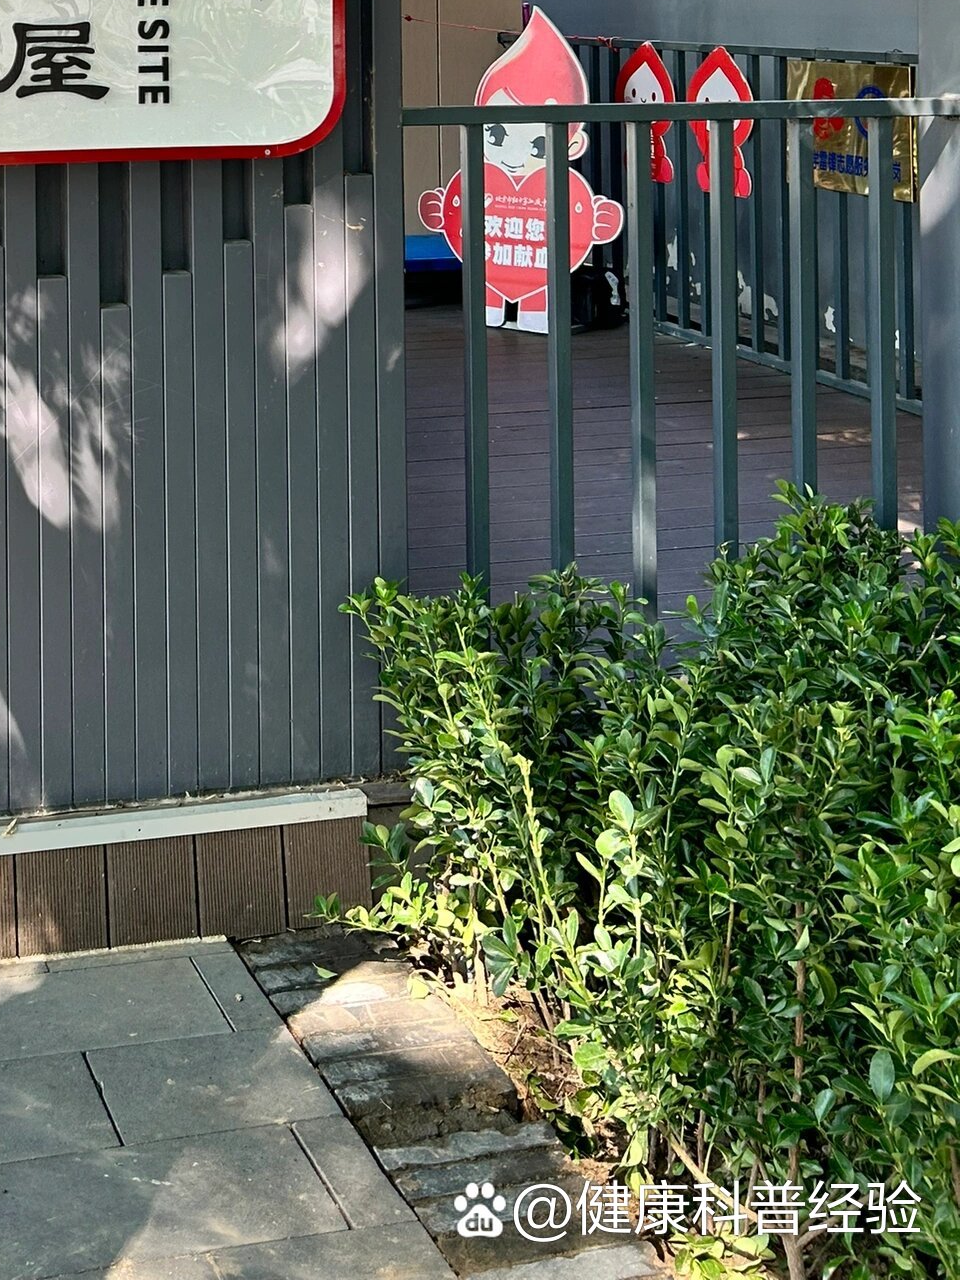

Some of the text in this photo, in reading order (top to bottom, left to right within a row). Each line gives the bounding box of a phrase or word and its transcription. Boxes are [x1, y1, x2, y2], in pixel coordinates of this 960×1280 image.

[137, 19, 170, 105] SITE
[484, 215, 545, 241] 欢迎您
